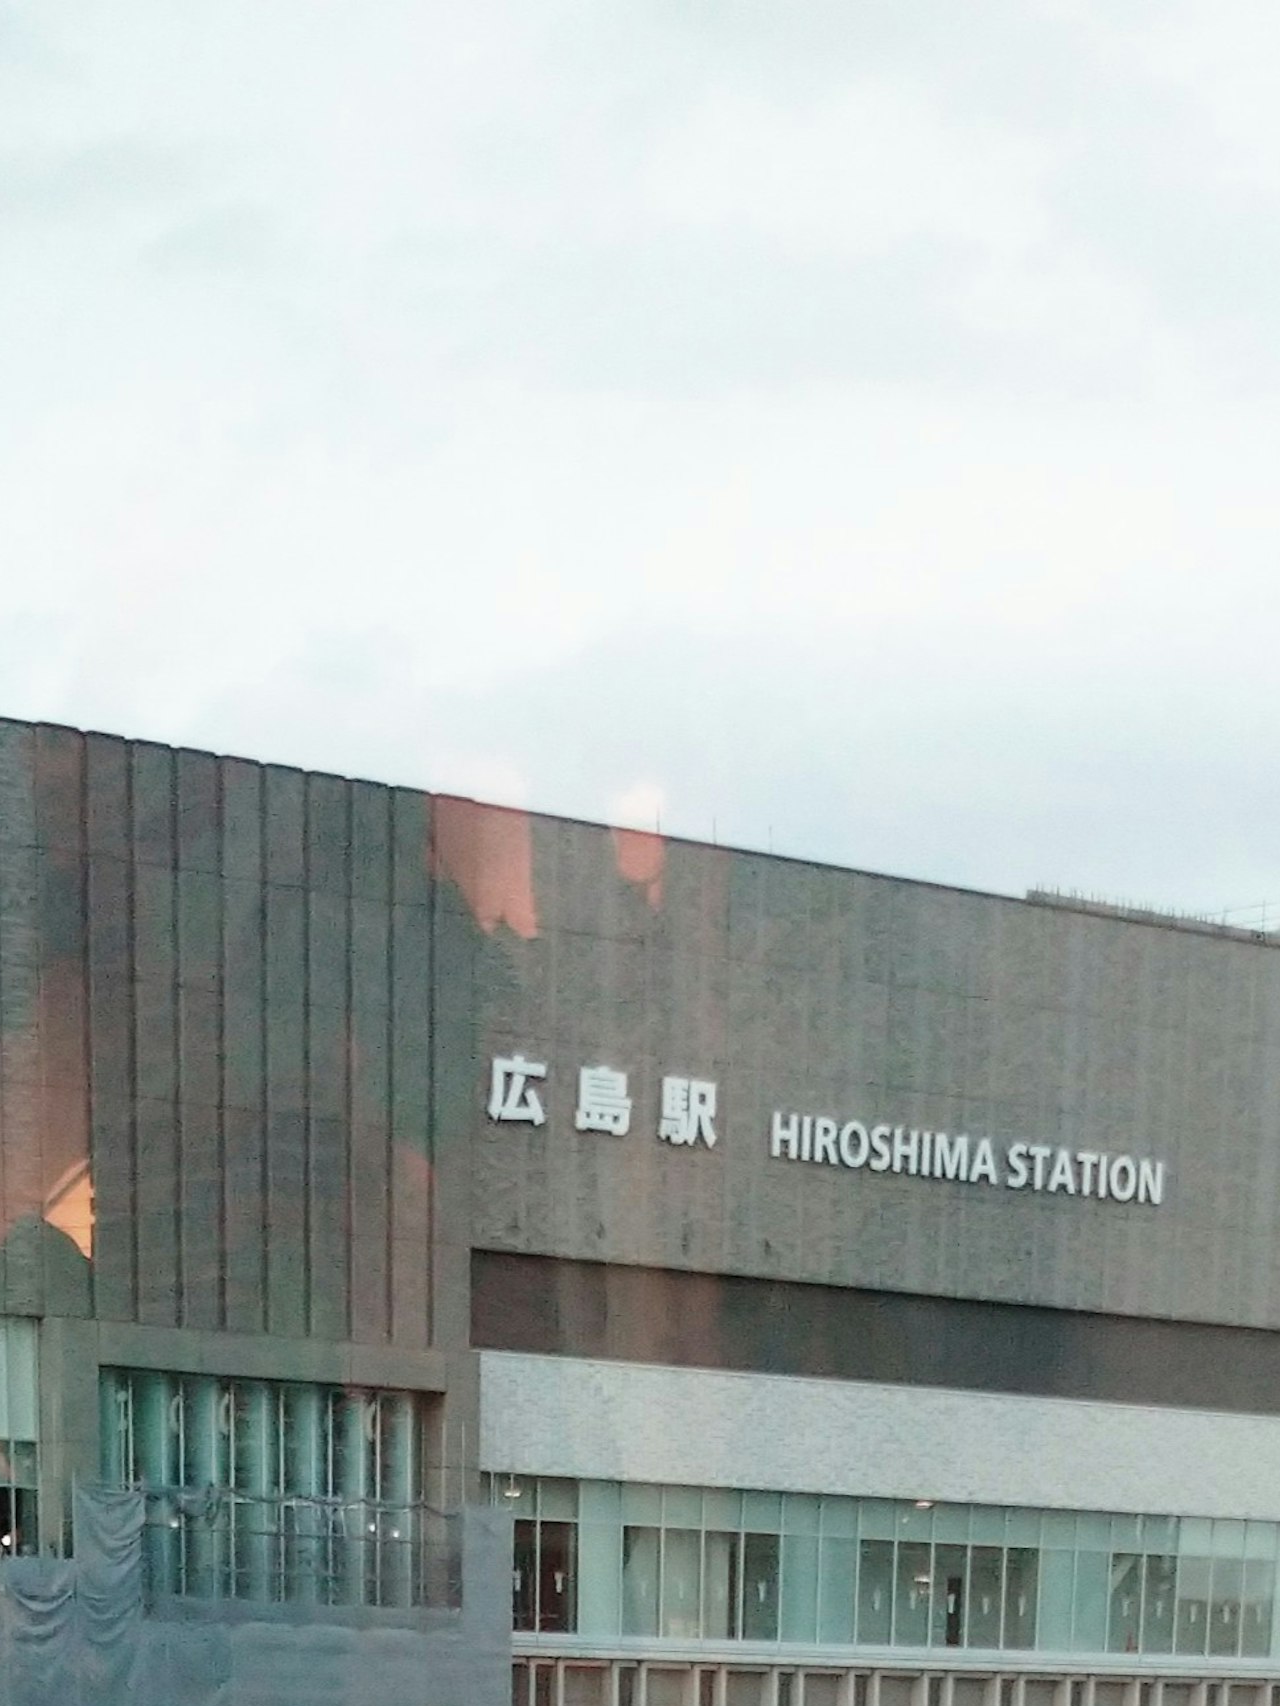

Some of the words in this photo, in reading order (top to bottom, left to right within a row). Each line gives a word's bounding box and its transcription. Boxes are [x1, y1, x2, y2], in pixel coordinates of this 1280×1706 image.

[488, 1055, 718, 1149] 広島駅
[771, 1110, 998, 1185] HIROSHIMA
[1006, 1142, 1163, 1206] STATION
